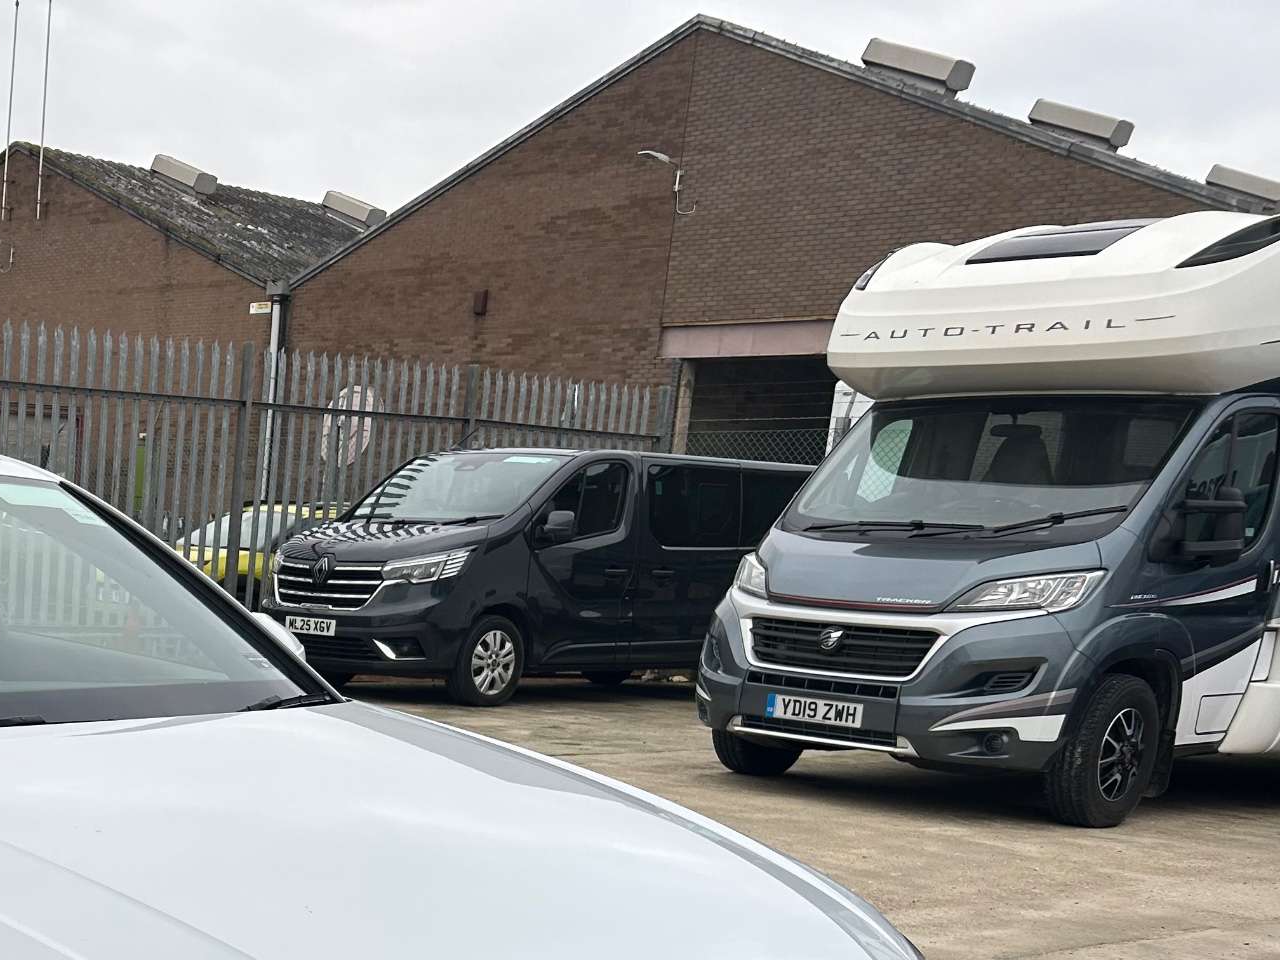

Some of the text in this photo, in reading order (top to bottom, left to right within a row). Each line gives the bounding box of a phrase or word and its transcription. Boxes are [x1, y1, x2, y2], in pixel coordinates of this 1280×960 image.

[863, 317, 1126, 341] AUTO-TRAIL
[313, 620, 332, 633] XGV
[782, 698, 857, 723] YD19 ZWH
